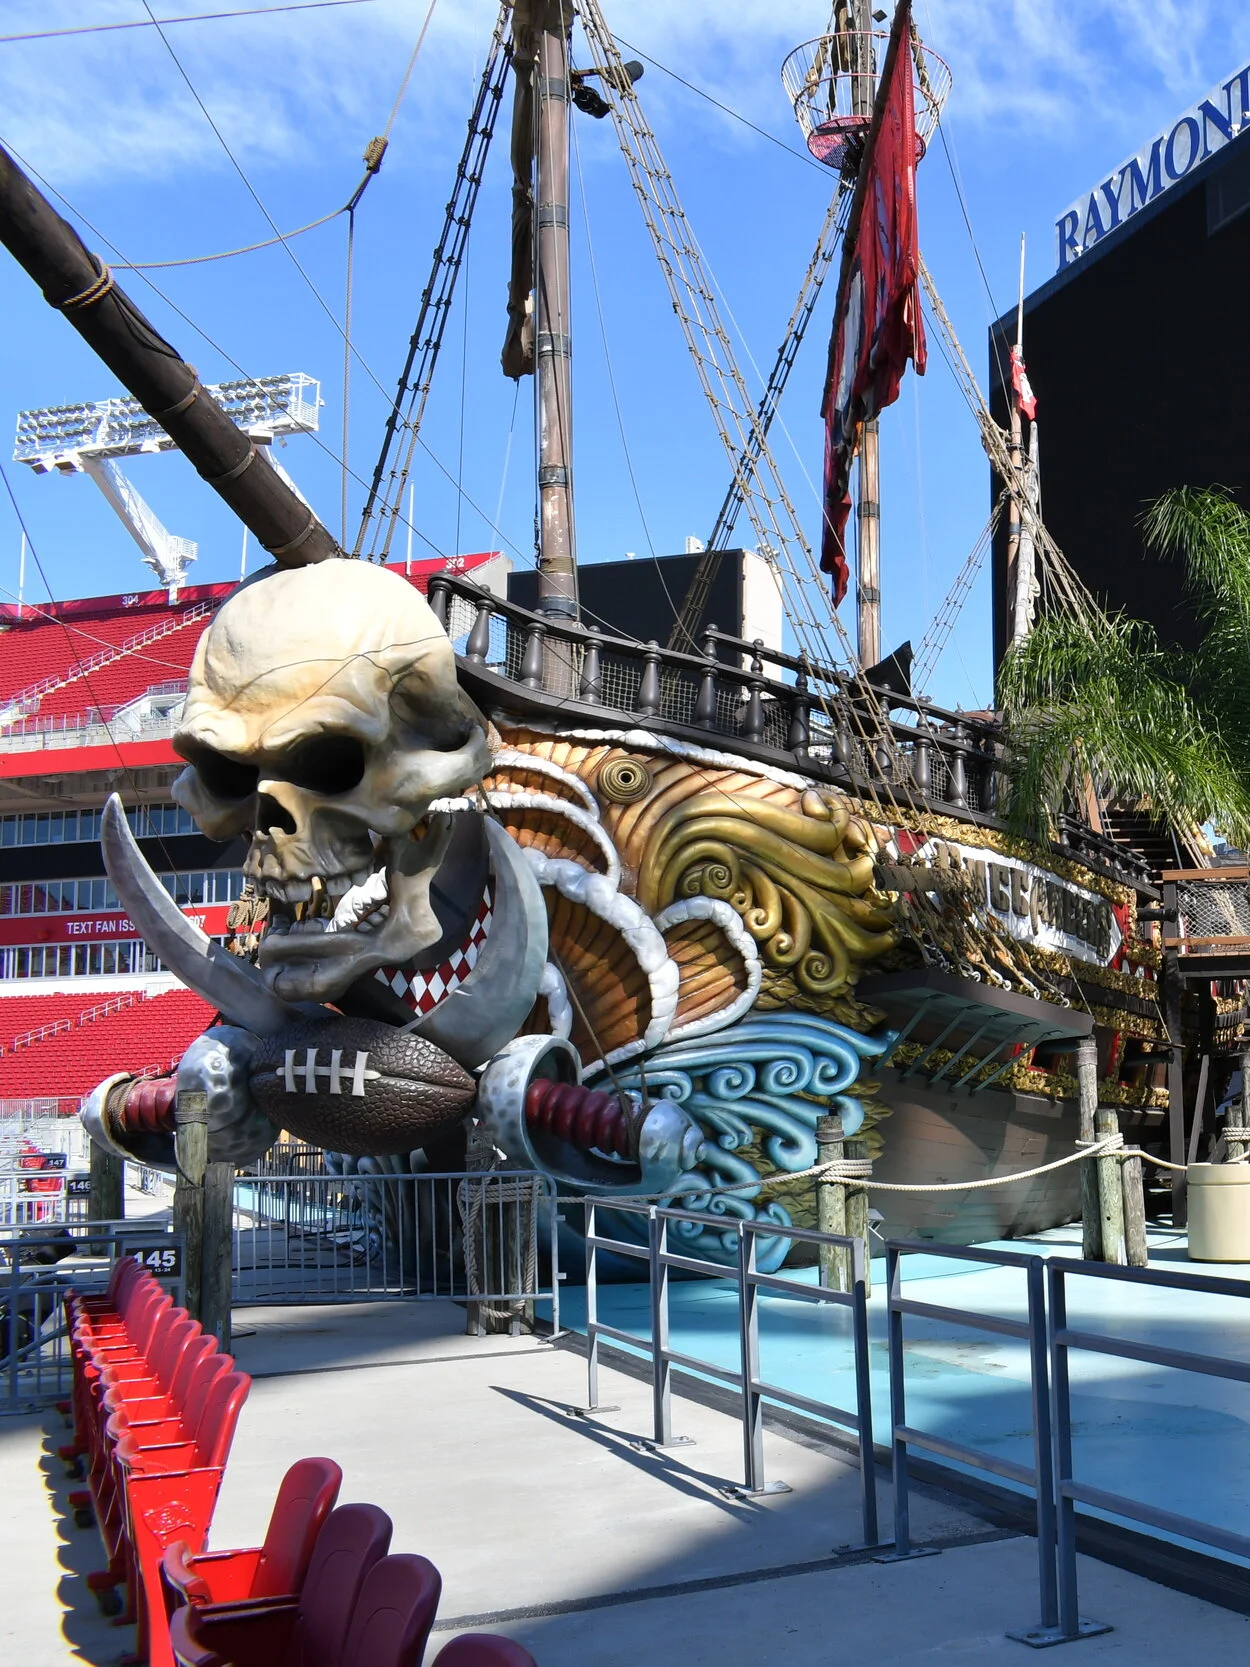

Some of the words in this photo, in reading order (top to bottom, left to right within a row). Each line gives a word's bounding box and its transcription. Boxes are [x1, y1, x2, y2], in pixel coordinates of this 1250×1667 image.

[122, 595, 139, 605] 304
[67, 921, 93, 935] TEXT
[95, 920, 116, 933] FAN
[119, 919, 136, 932] ISS
[70, 1181, 91, 1190] 146
[133, 1250, 176, 1267] 145
